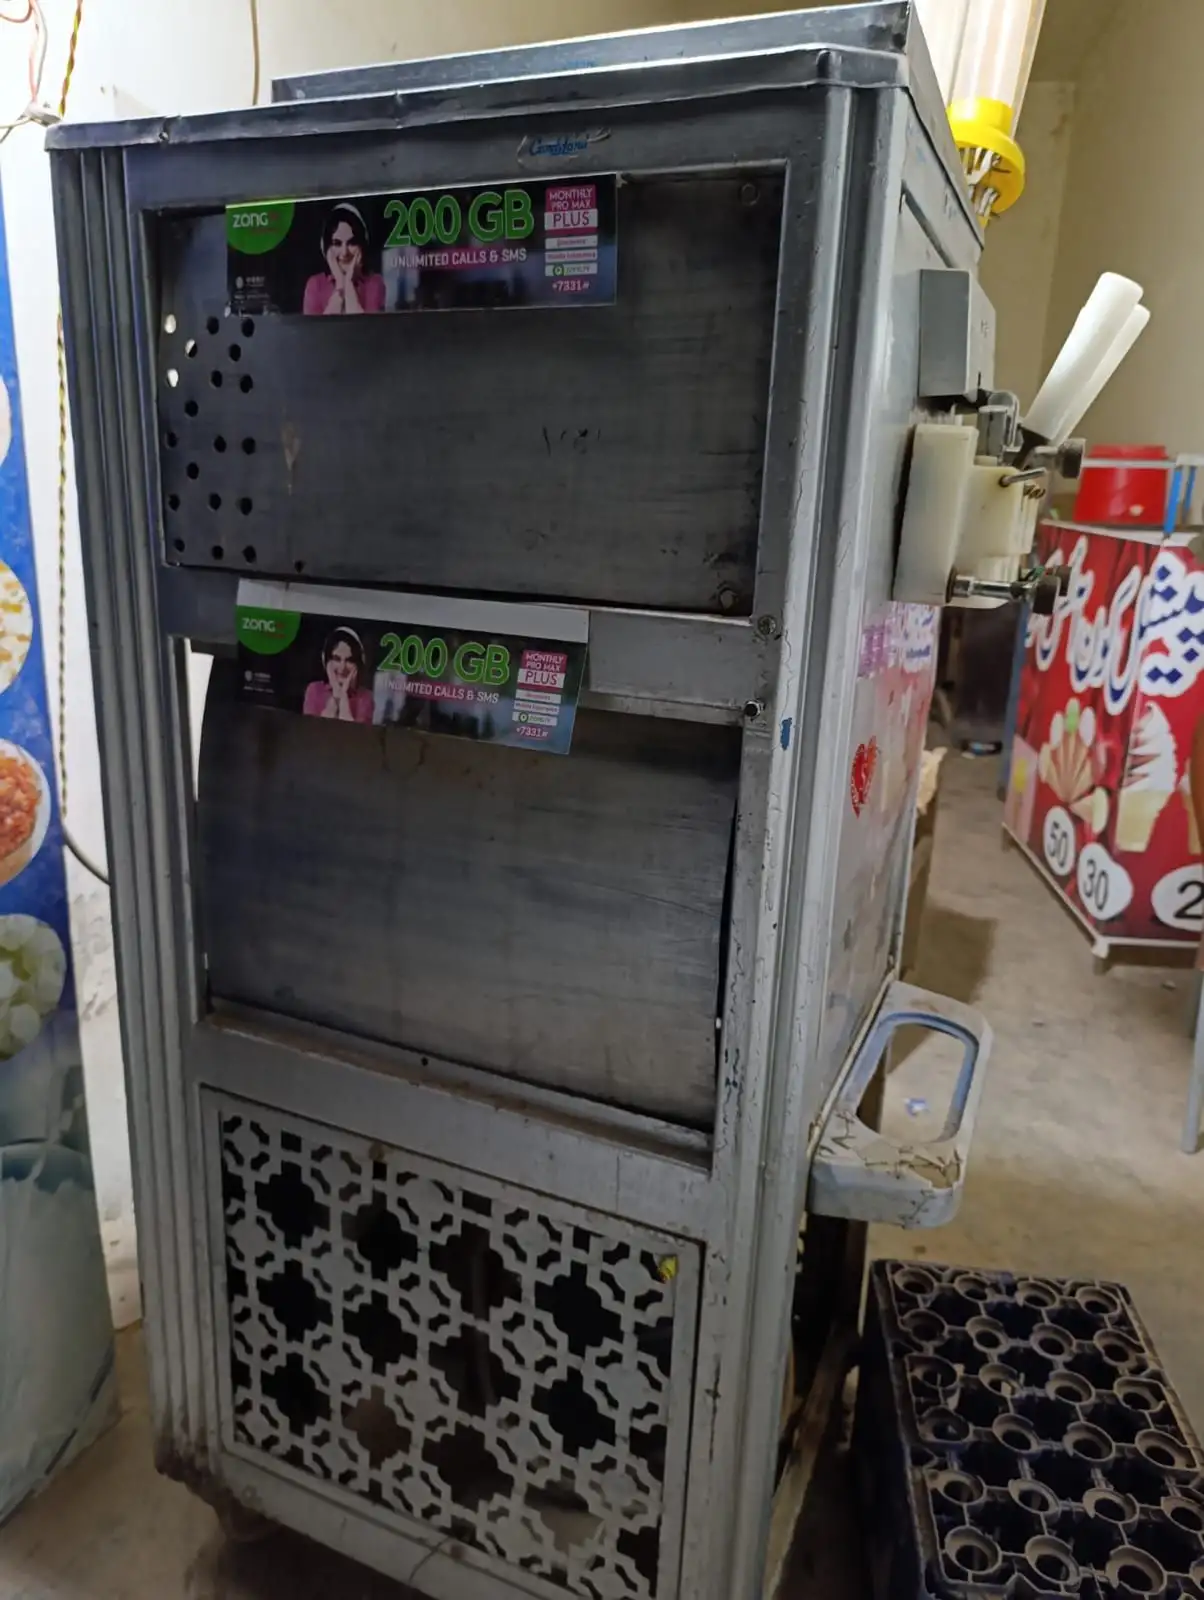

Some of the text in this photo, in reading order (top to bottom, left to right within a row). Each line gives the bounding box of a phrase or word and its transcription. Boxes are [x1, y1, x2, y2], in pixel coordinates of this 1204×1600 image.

[549, 187, 593, 201] MONTHLY
[551, 199, 592, 212] PRO MAX
[383, 188, 535, 248] 200 GB
[553, 211, 590, 229] PLUS
[451, 249, 487, 267] CALLS
[489, 250, 499, 264] &
[501, 246, 528, 263] SMS
[376, 632, 511, 686] 200 GB
[525, 652, 564, 665] MONTHLY
[524, 670, 558, 686] PLUS
[433, 685, 465, 700] CALLS
[476, 691, 500, 705] SMS
[1047, 820, 1068, 869] 50
[1083, 858, 1110, 911] 30
